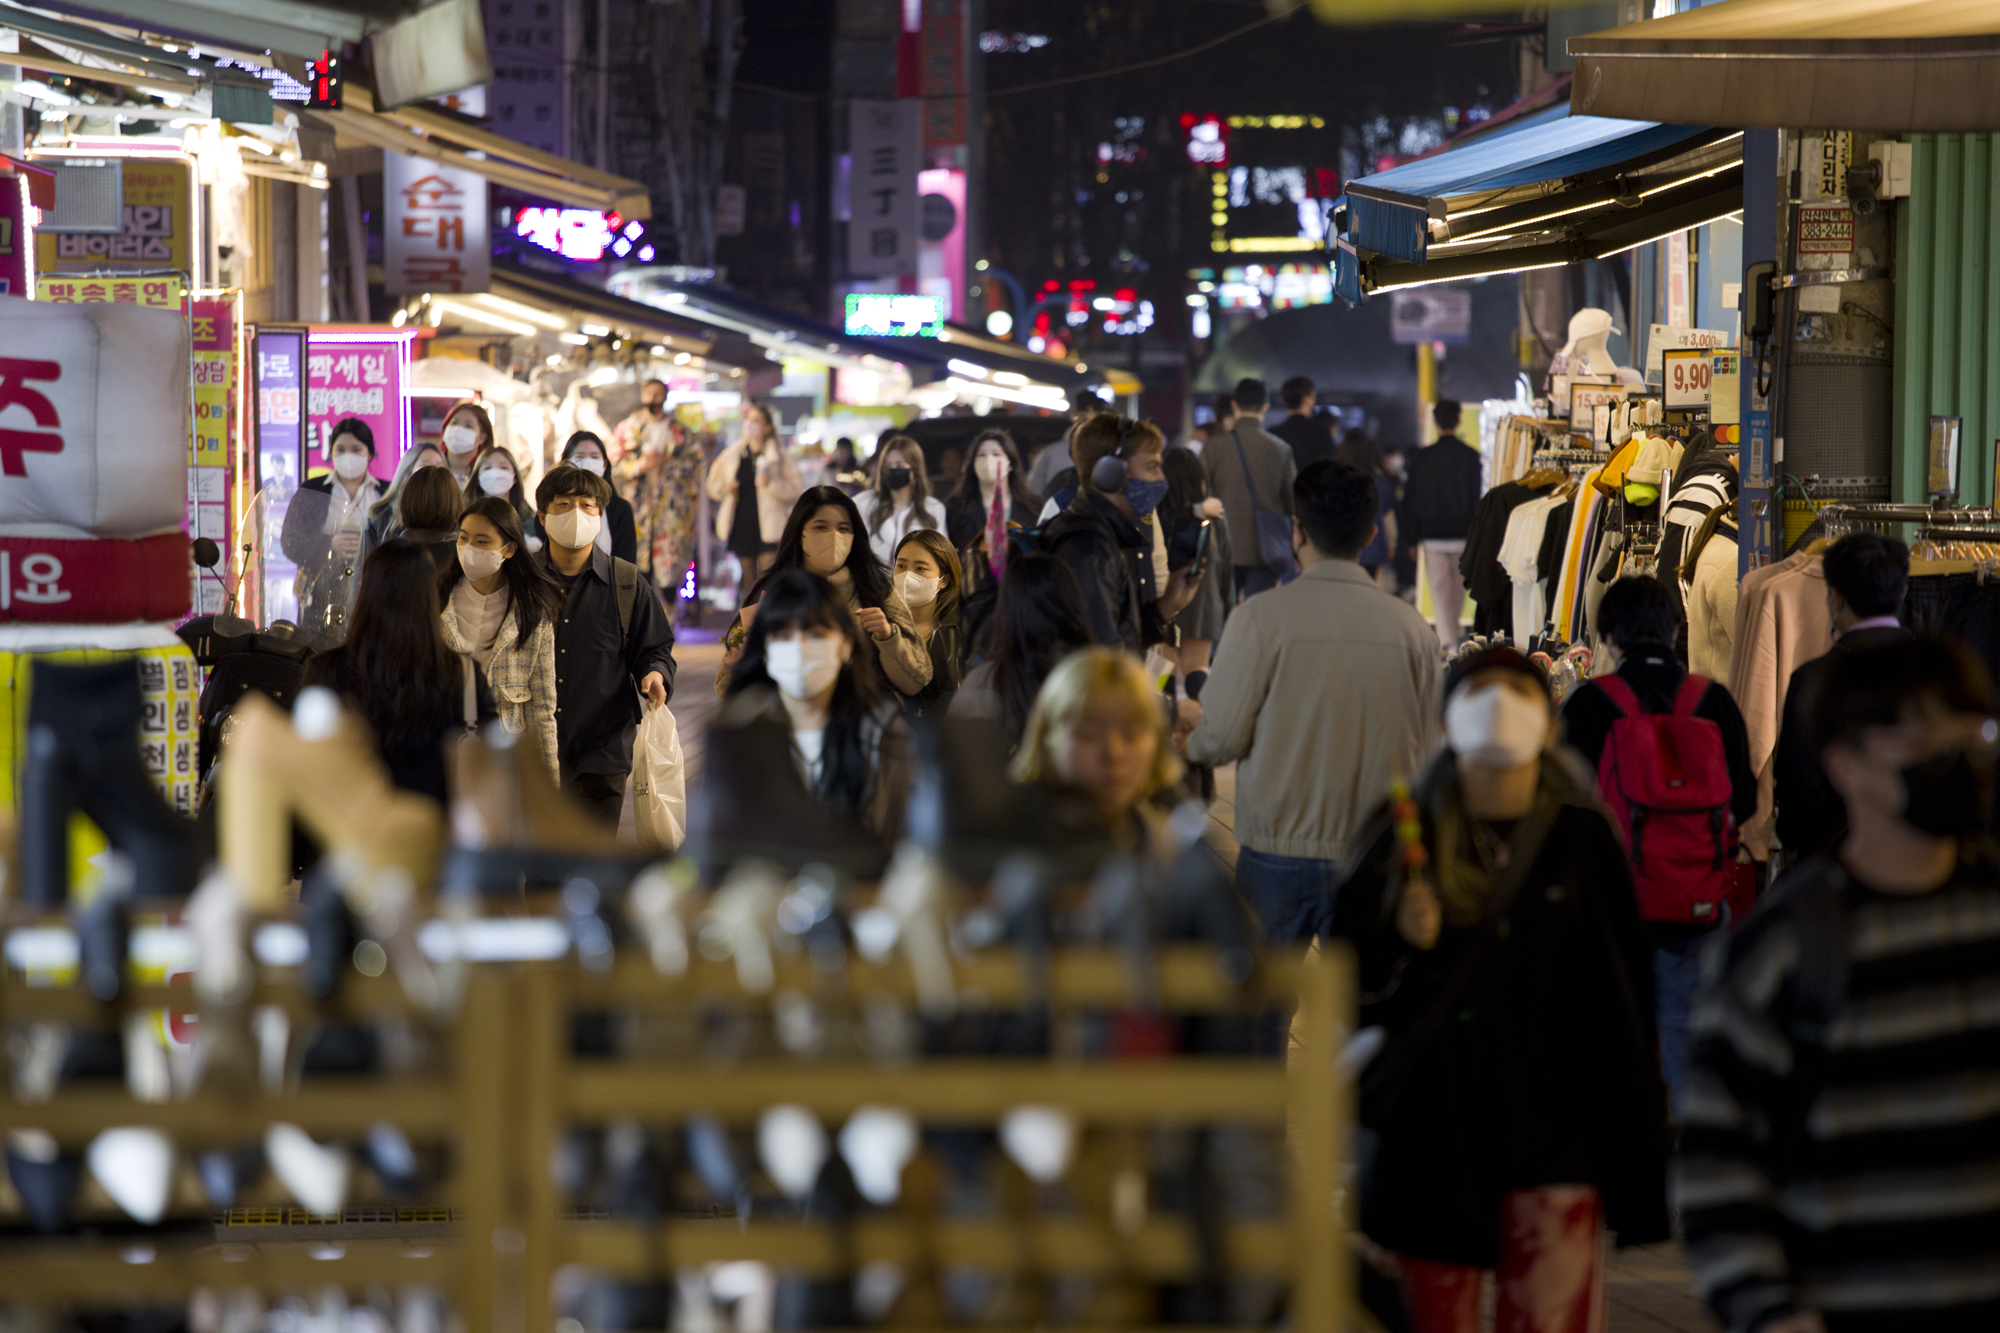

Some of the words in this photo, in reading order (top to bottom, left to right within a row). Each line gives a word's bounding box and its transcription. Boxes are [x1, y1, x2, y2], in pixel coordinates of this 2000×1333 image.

[402, 175, 465, 292] 순대국
[1804, 224, 1851, 238] 383-2444
[58, 233, 173, 259] 바이러스
[48, 282, 169, 306] 방송출연
[184, 316, 217, 342] 조
[193, 361, 226, 385] 상담
[1674, 362, 1712, 393] 9,90
[0, 552, 72, 610] 요
[273, 622, 294, 632] HONDA
